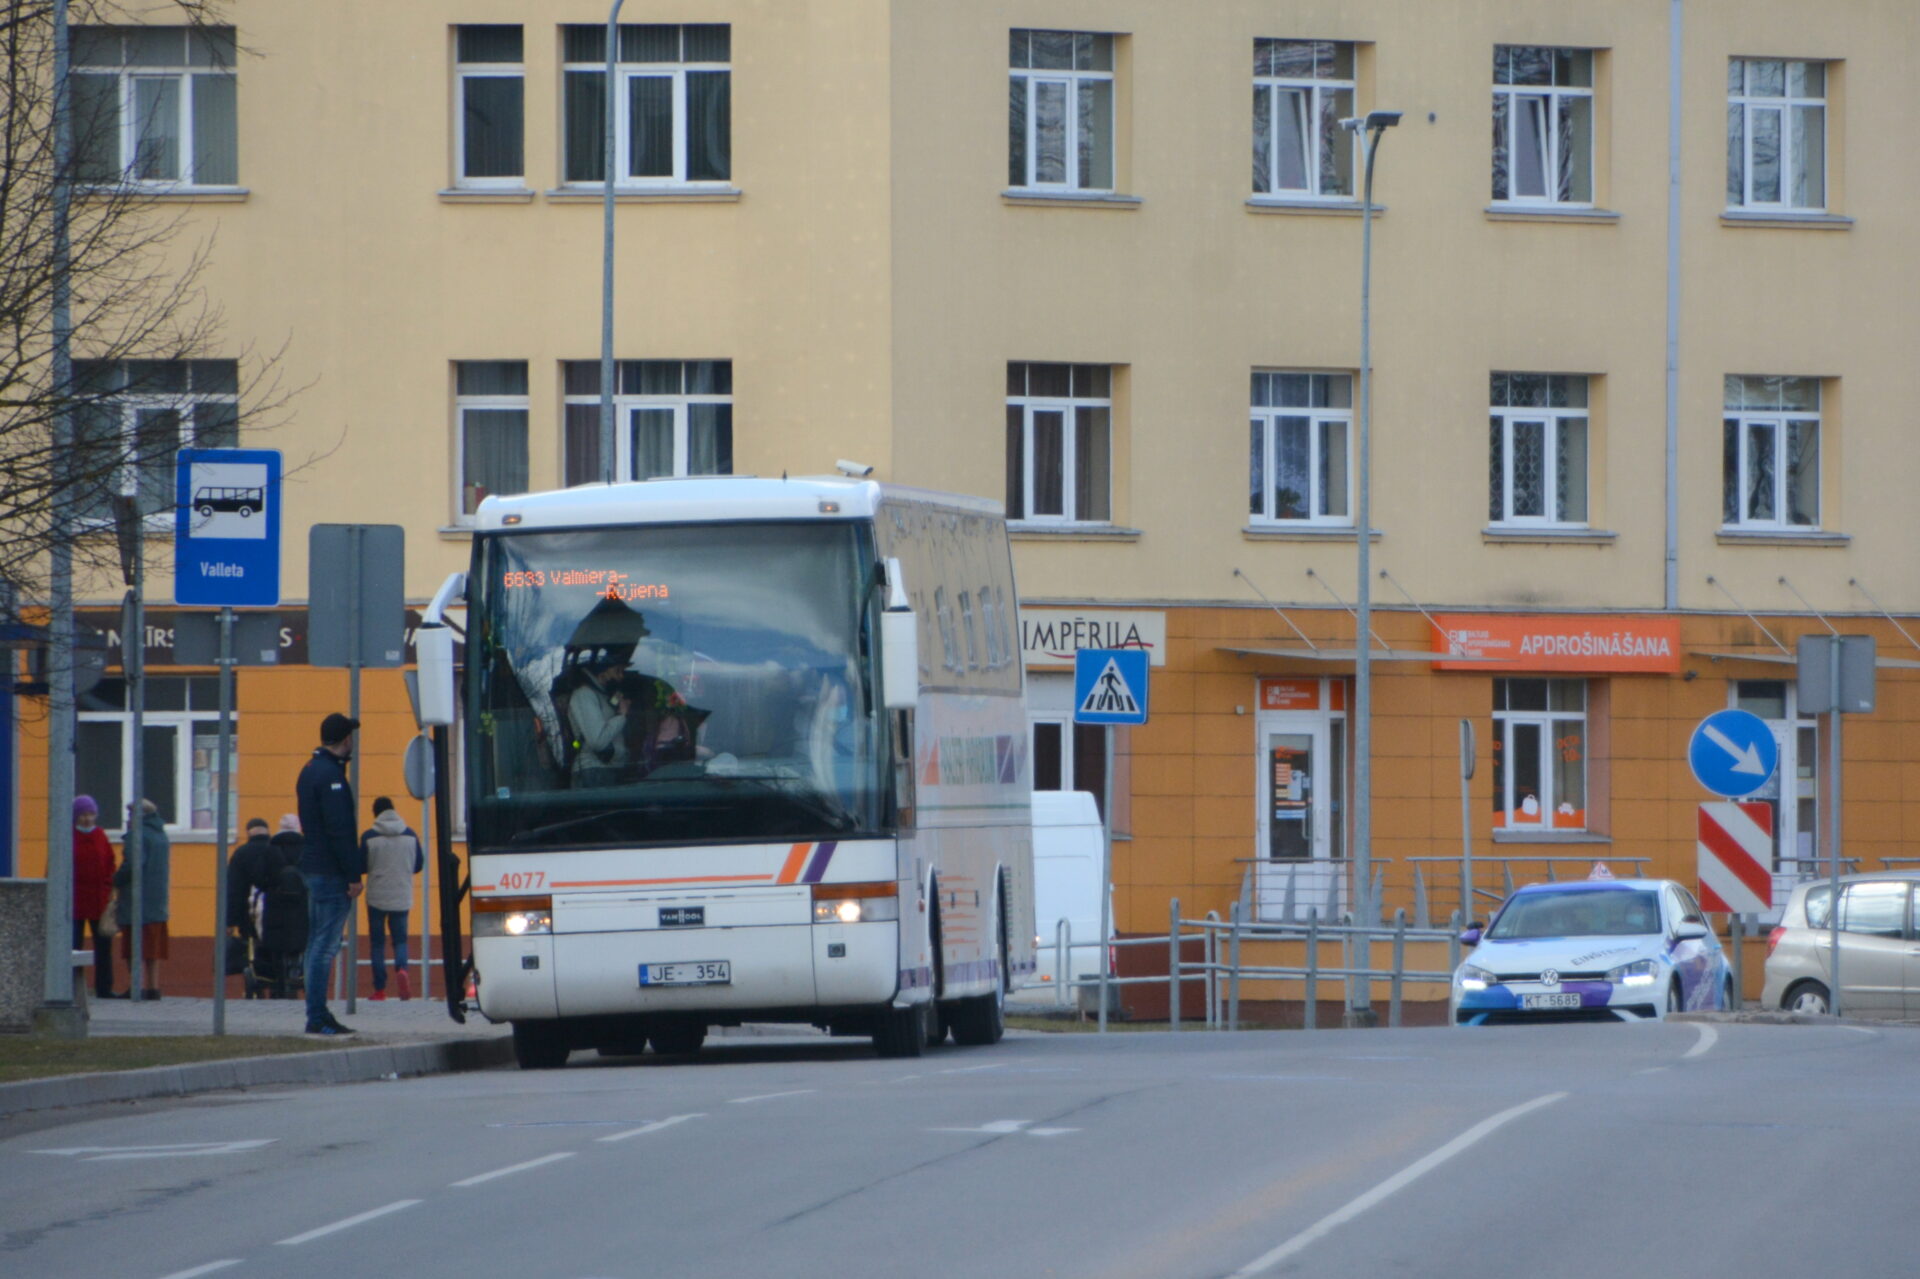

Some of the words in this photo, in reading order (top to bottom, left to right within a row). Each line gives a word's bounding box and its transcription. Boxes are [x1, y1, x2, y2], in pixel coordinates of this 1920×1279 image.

[200, 561, 244, 577] Valleta
[503, 571, 546, 587] 6633
[550, 569, 629, 585] Valmiera-
[1519, 631, 1671, 656] APDROŠINĀŠANA
[499, 871, 545, 889] 4077
[696, 963, 726, 980] 354
